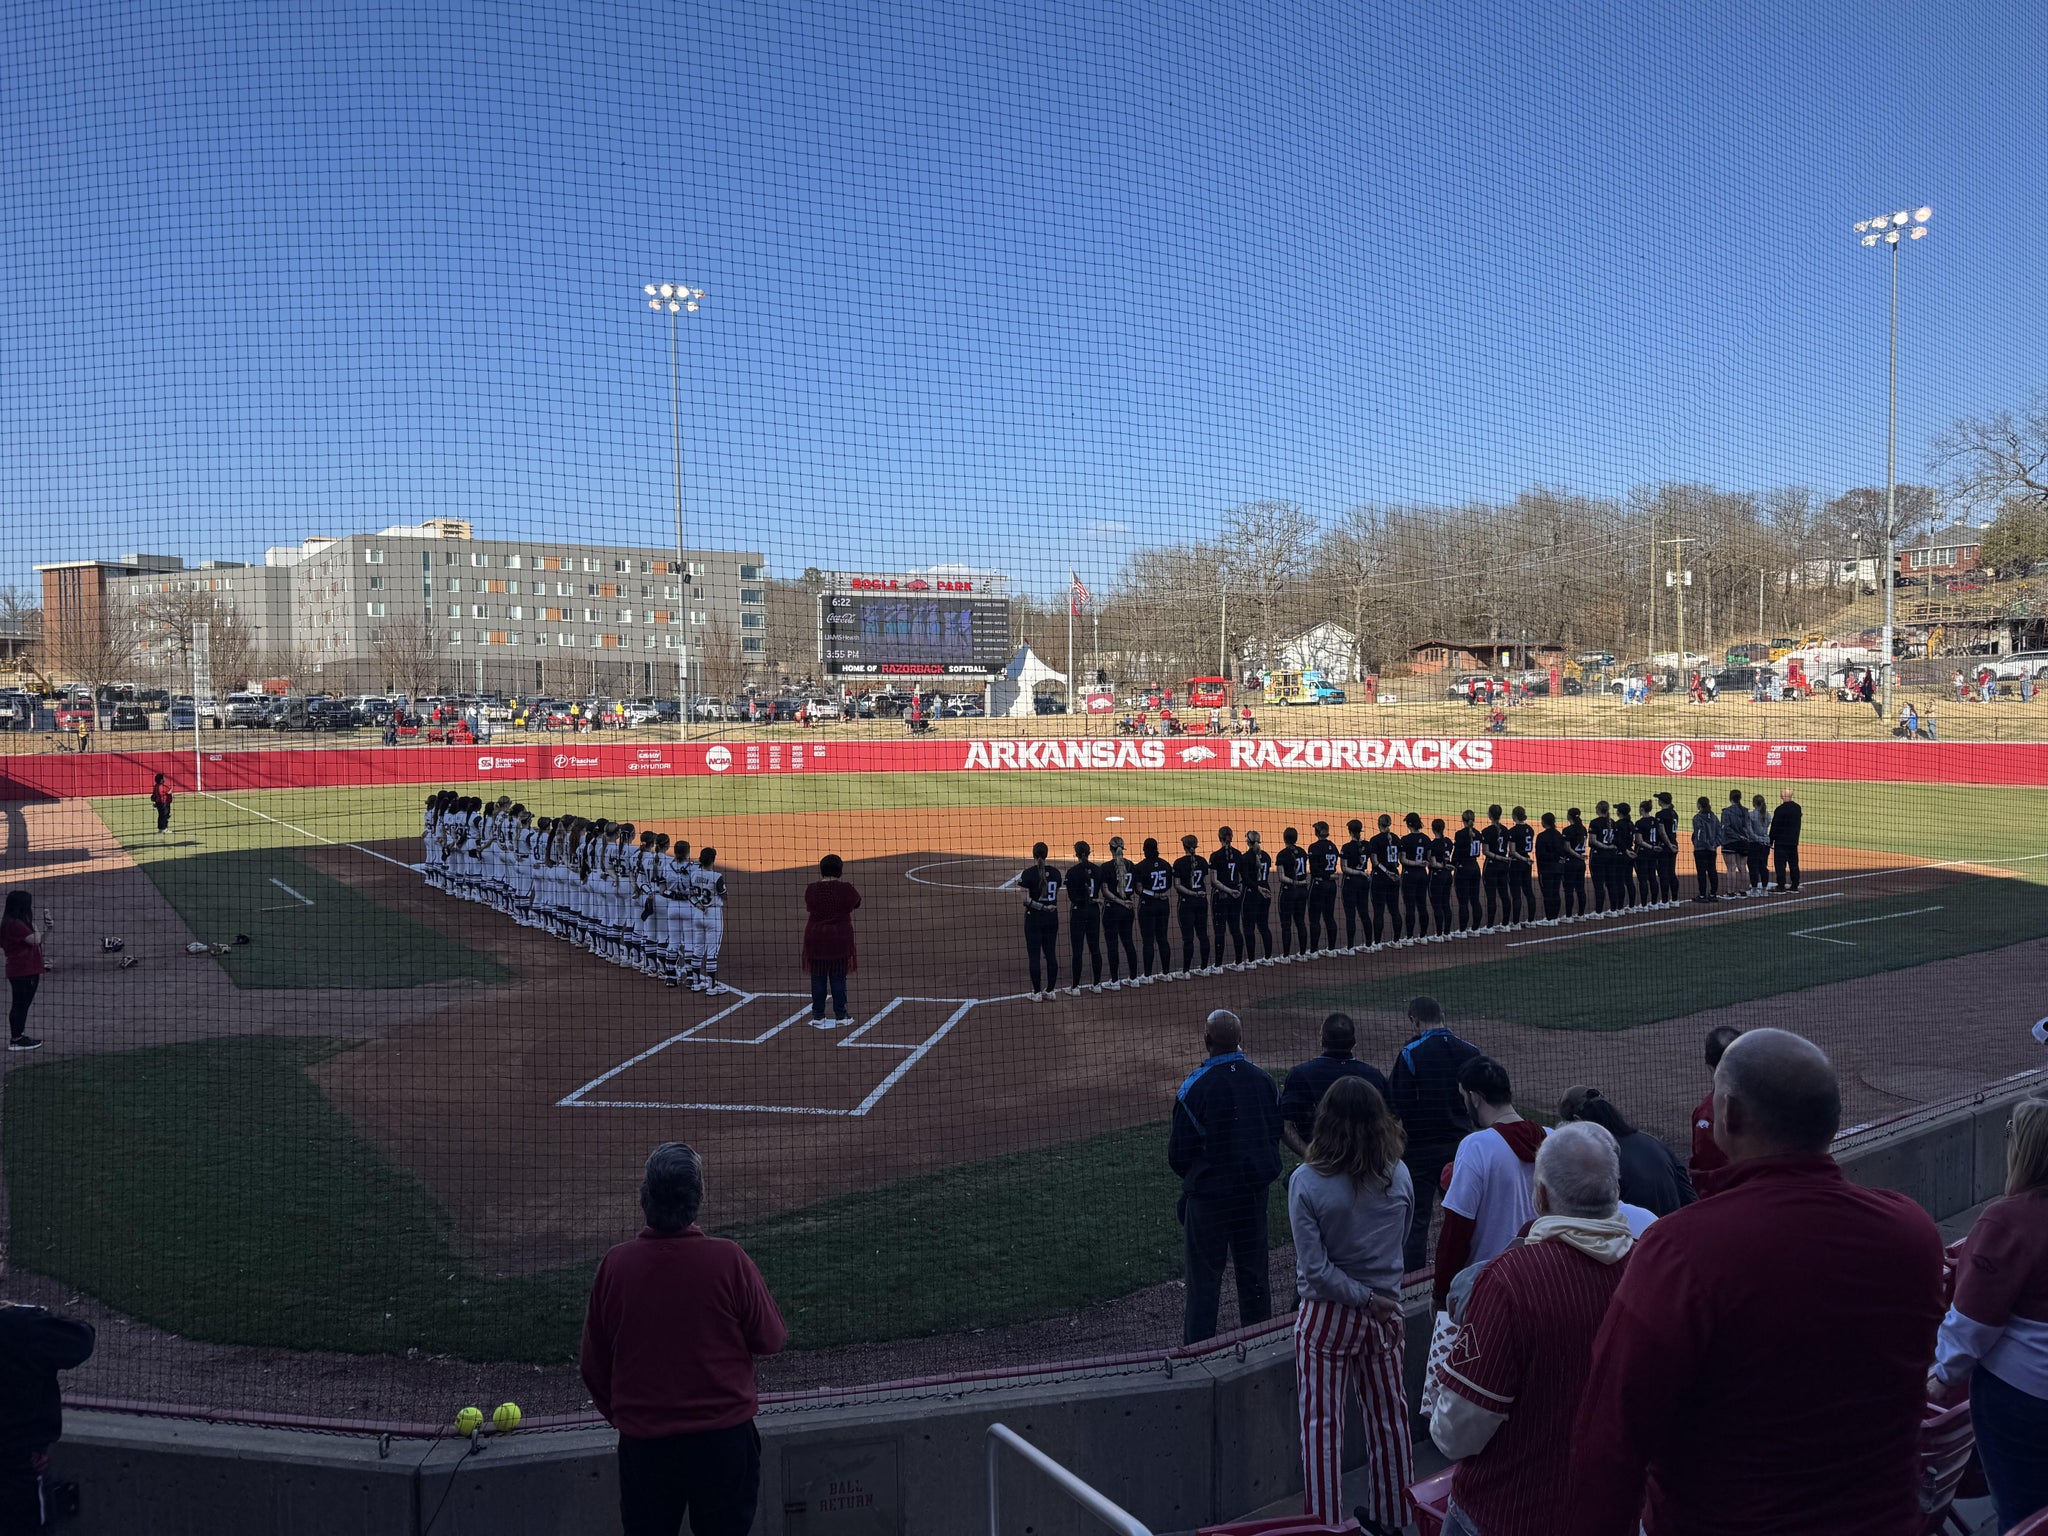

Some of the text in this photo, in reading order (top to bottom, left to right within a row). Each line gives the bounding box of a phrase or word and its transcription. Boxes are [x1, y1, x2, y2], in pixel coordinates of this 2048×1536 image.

[852, 578, 973, 591] BOGLE PARK
[832, 598, 851, 607] 6:22
[826, 613, 856, 624] Coca-Cola
[826, 650, 859, 659] 3:55 PM
[882, 664, 944, 673] RAZORBACK
[949, 665, 987, 673] SOFTBALL
[964, 740, 1493, 770] ARKANSAS RAZORBACKS
[1664, 745, 1690, 770] SEC
[1150, 870, 1167, 890] 25
[1454, 1332, 1470, 1358] A
[830, 1480, 864, 1495] BALL
[820, 1494, 874, 1512] RETURN
